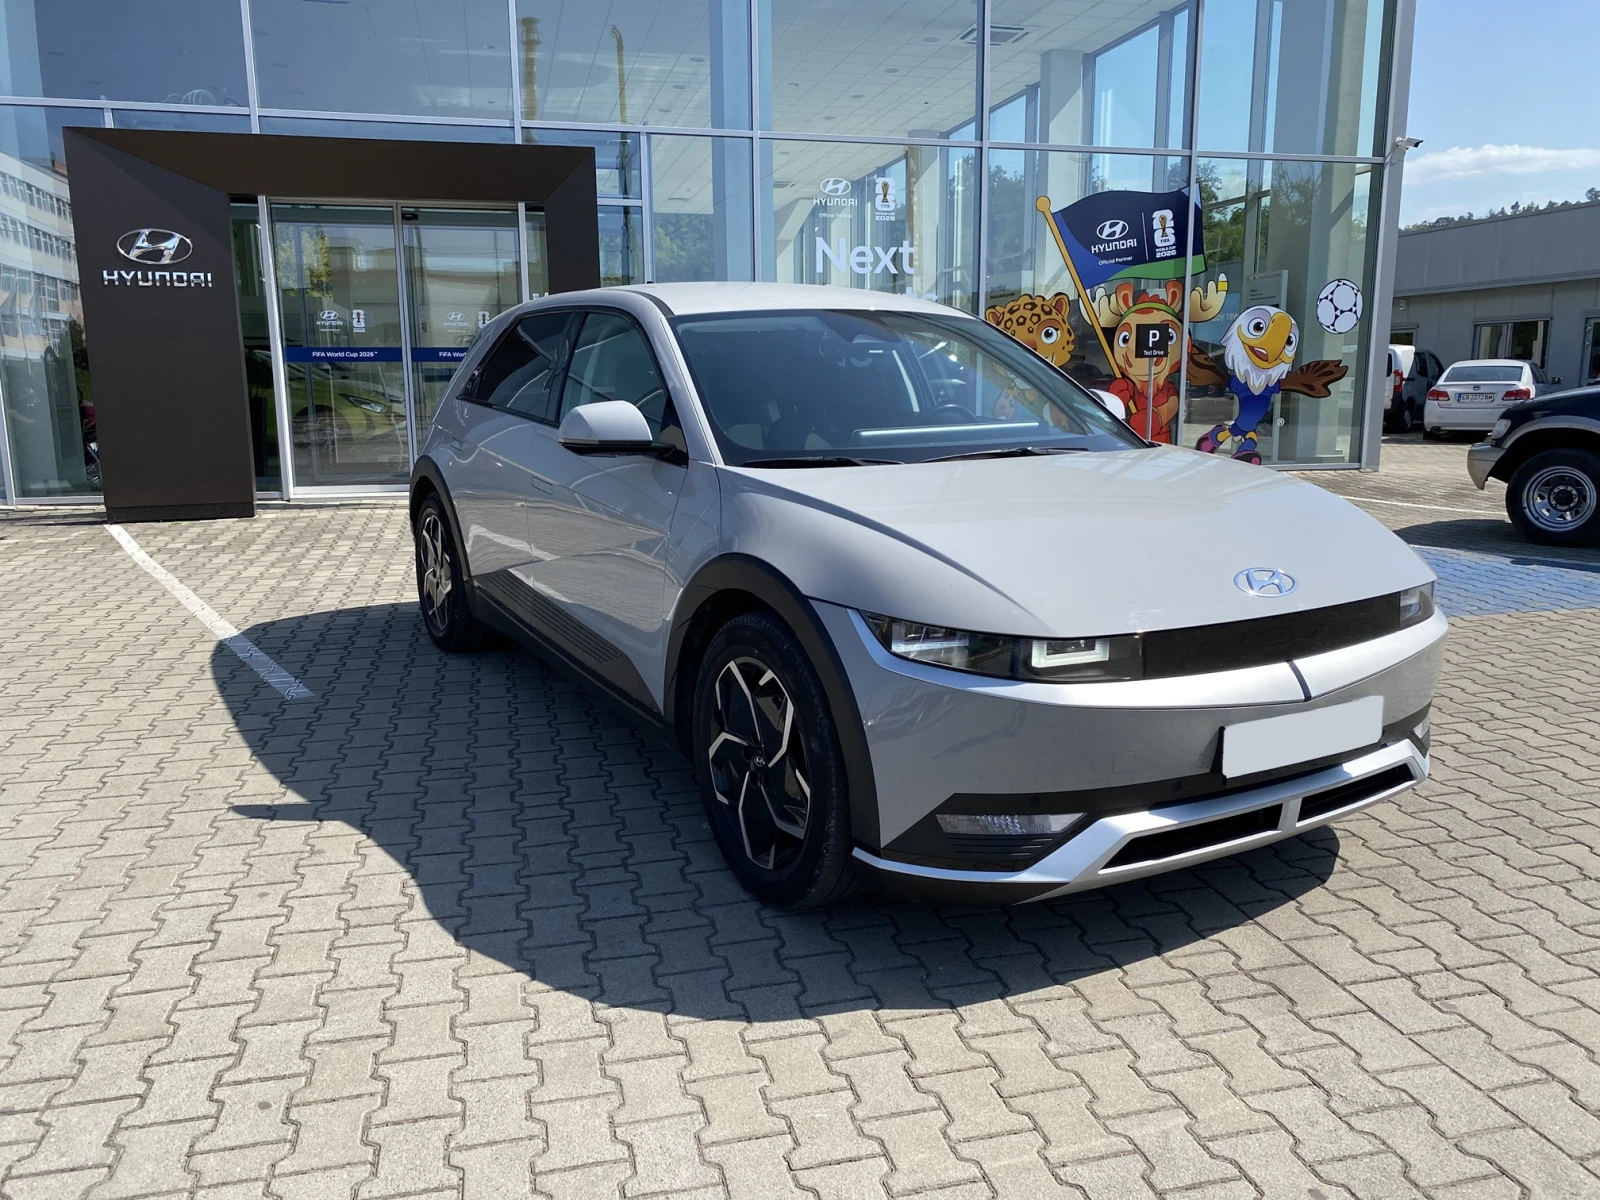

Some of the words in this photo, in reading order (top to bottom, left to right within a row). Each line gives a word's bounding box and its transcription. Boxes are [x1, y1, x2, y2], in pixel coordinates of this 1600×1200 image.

[813, 198, 858, 207] HYUNDAI
[1091, 239, 1137, 254] HYUNDAI
[1155, 250, 1177, 258] 2026
[815, 236, 915, 274] Next
[102, 269, 213, 287] HYUNDAI
[1148, 330, 1160, 347] P
